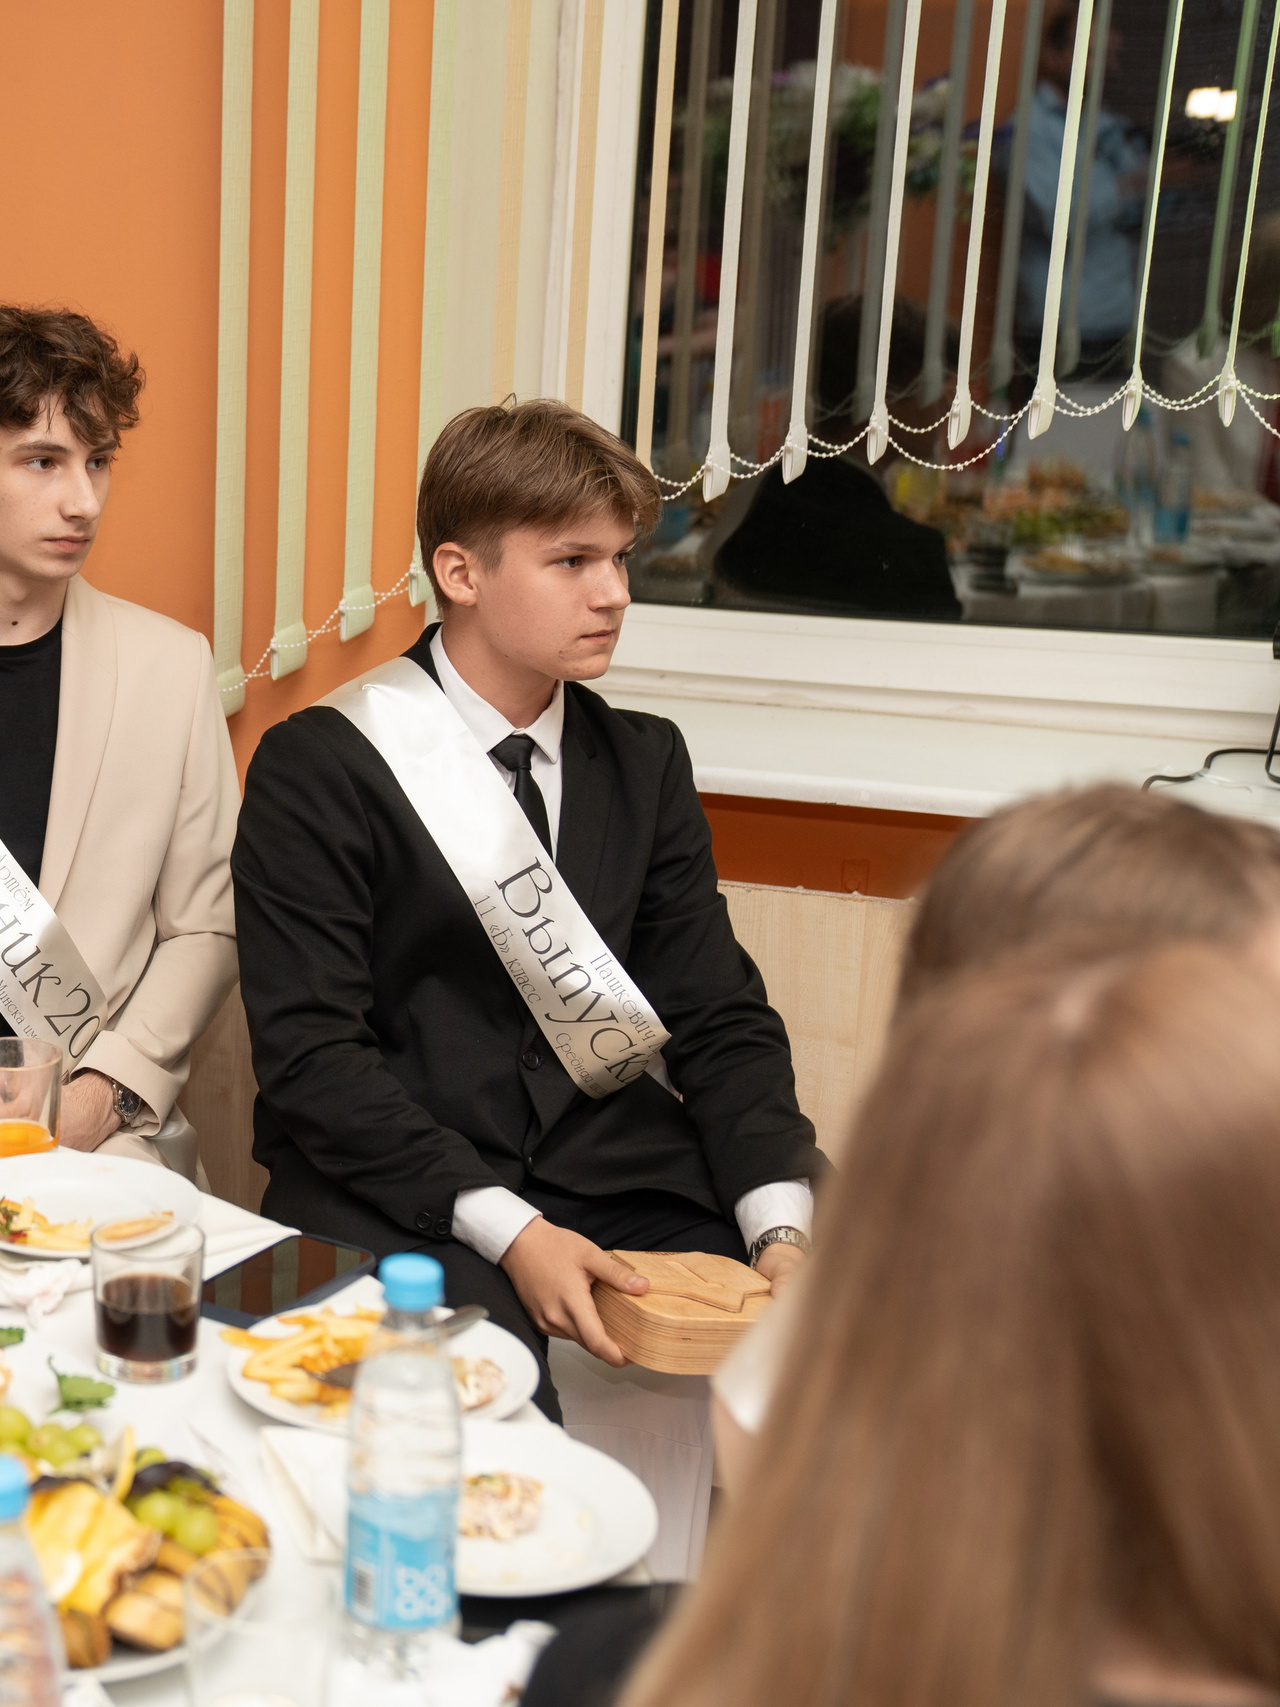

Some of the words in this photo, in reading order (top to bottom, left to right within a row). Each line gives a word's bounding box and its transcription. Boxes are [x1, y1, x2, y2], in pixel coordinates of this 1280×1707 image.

[473, 895, 496, 918] 11
[505, 958, 542, 1004] класс
[589, 952, 657, 1041] Пашкевич
[23, 1025, 40, 1040] им
[555, 1032, 593, 1084] Средняя
